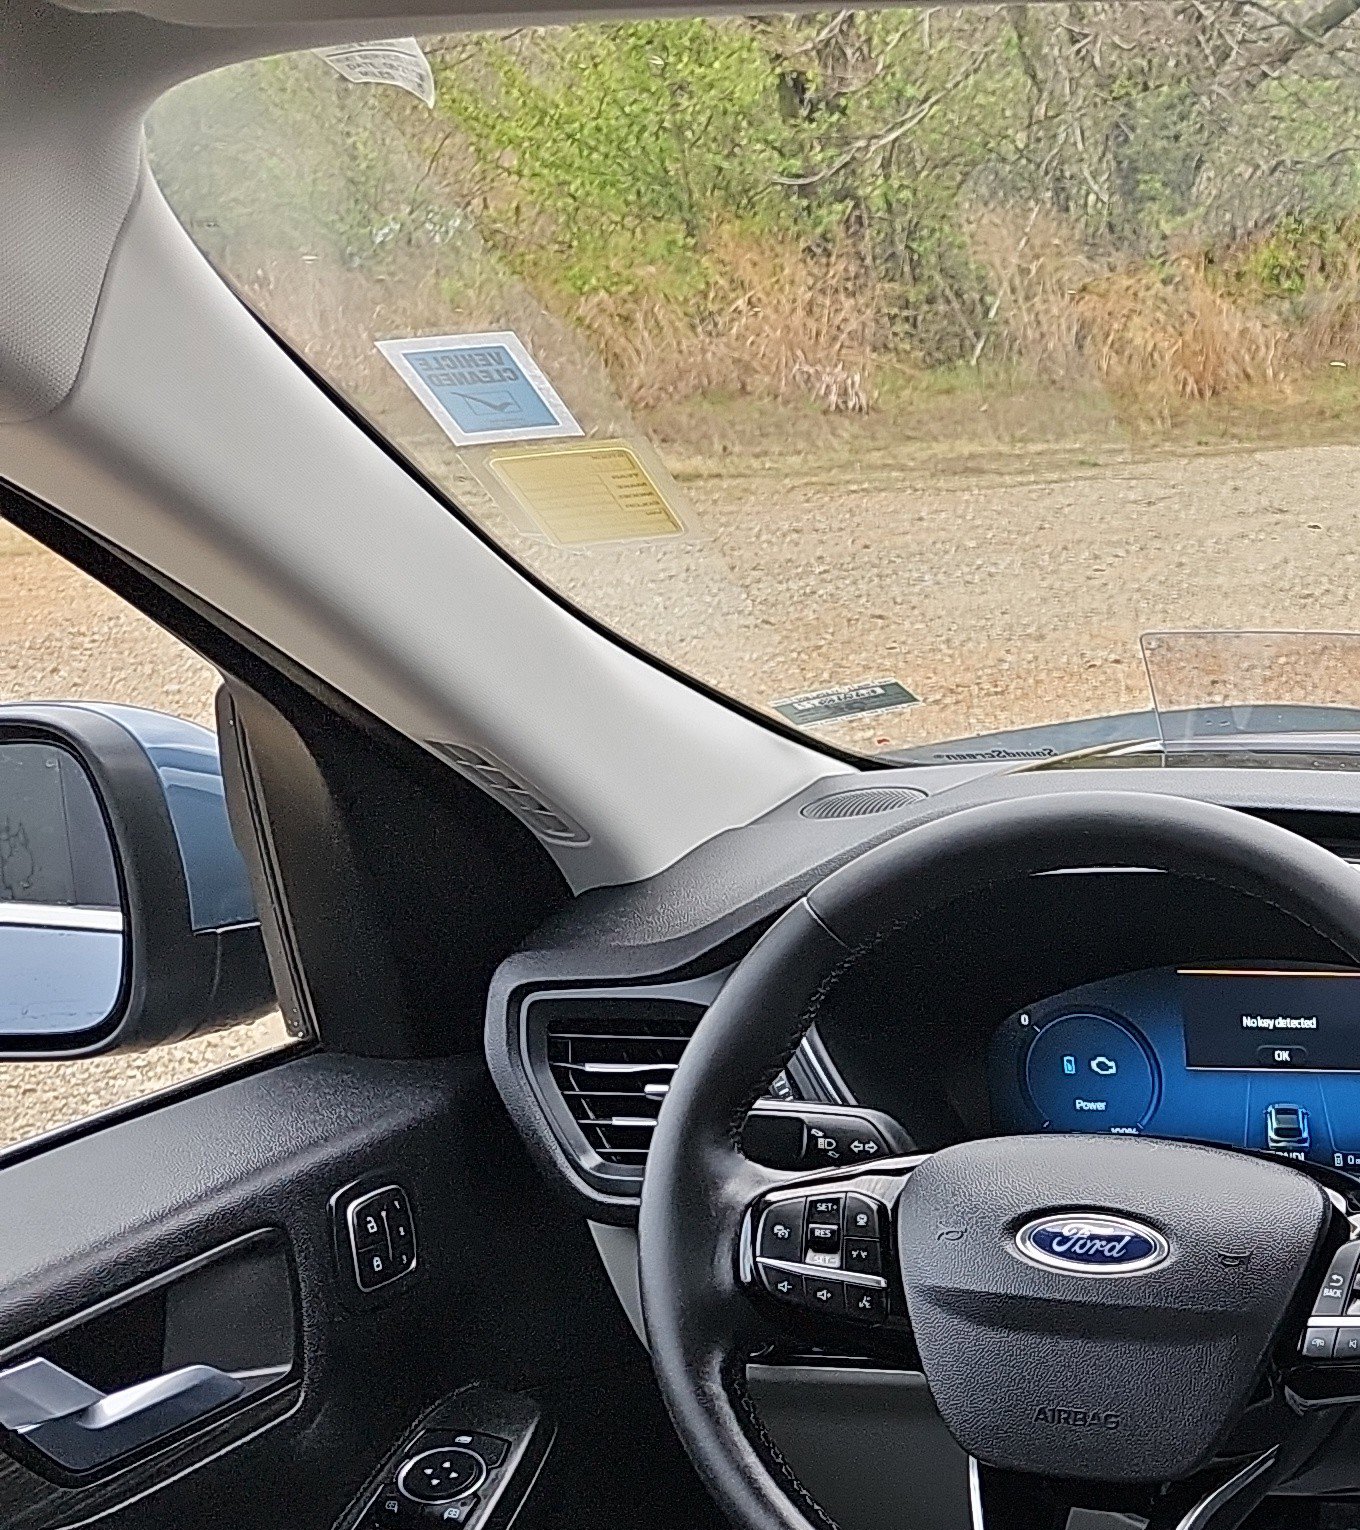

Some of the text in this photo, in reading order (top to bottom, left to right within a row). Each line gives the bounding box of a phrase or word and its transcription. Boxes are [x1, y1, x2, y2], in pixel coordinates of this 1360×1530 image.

[1275, 1017, 1317, 1029] detected
[1274, 1050, 1291, 1061] OK
[1075, 1099, 1106, 1110] Power
[814, 1229, 832, 1238] RES
[1051, 1223, 1131, 1258] Ford
[1323, 1288, 1342, 1298] BACK
[1032, 1405, 1121, 1431] AIRBAG
